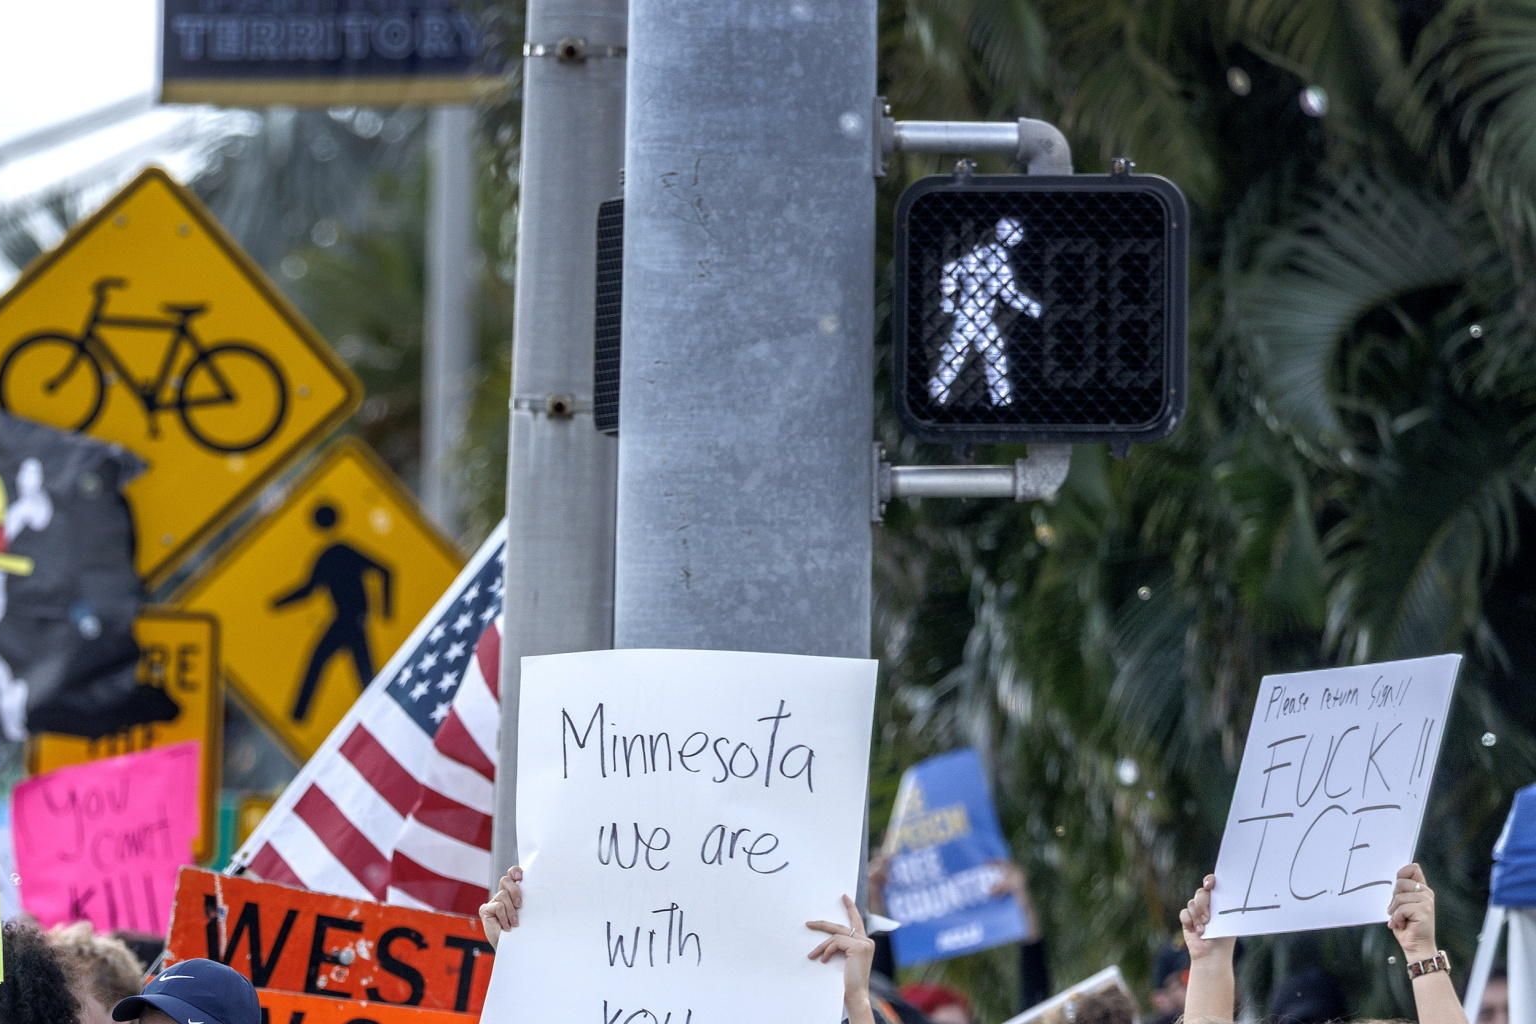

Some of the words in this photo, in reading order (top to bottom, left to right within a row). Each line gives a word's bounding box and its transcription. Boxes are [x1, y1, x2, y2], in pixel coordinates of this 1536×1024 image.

[170, 16, 484, 60] TERRITORY
[1264, 685, 1310, 722] Please
[1320, 686, 1359, 711] return
[561, 699, 816, 793] Minnesota
[700, 823, 790, 874] are
[606, 902, 703, 968] with
